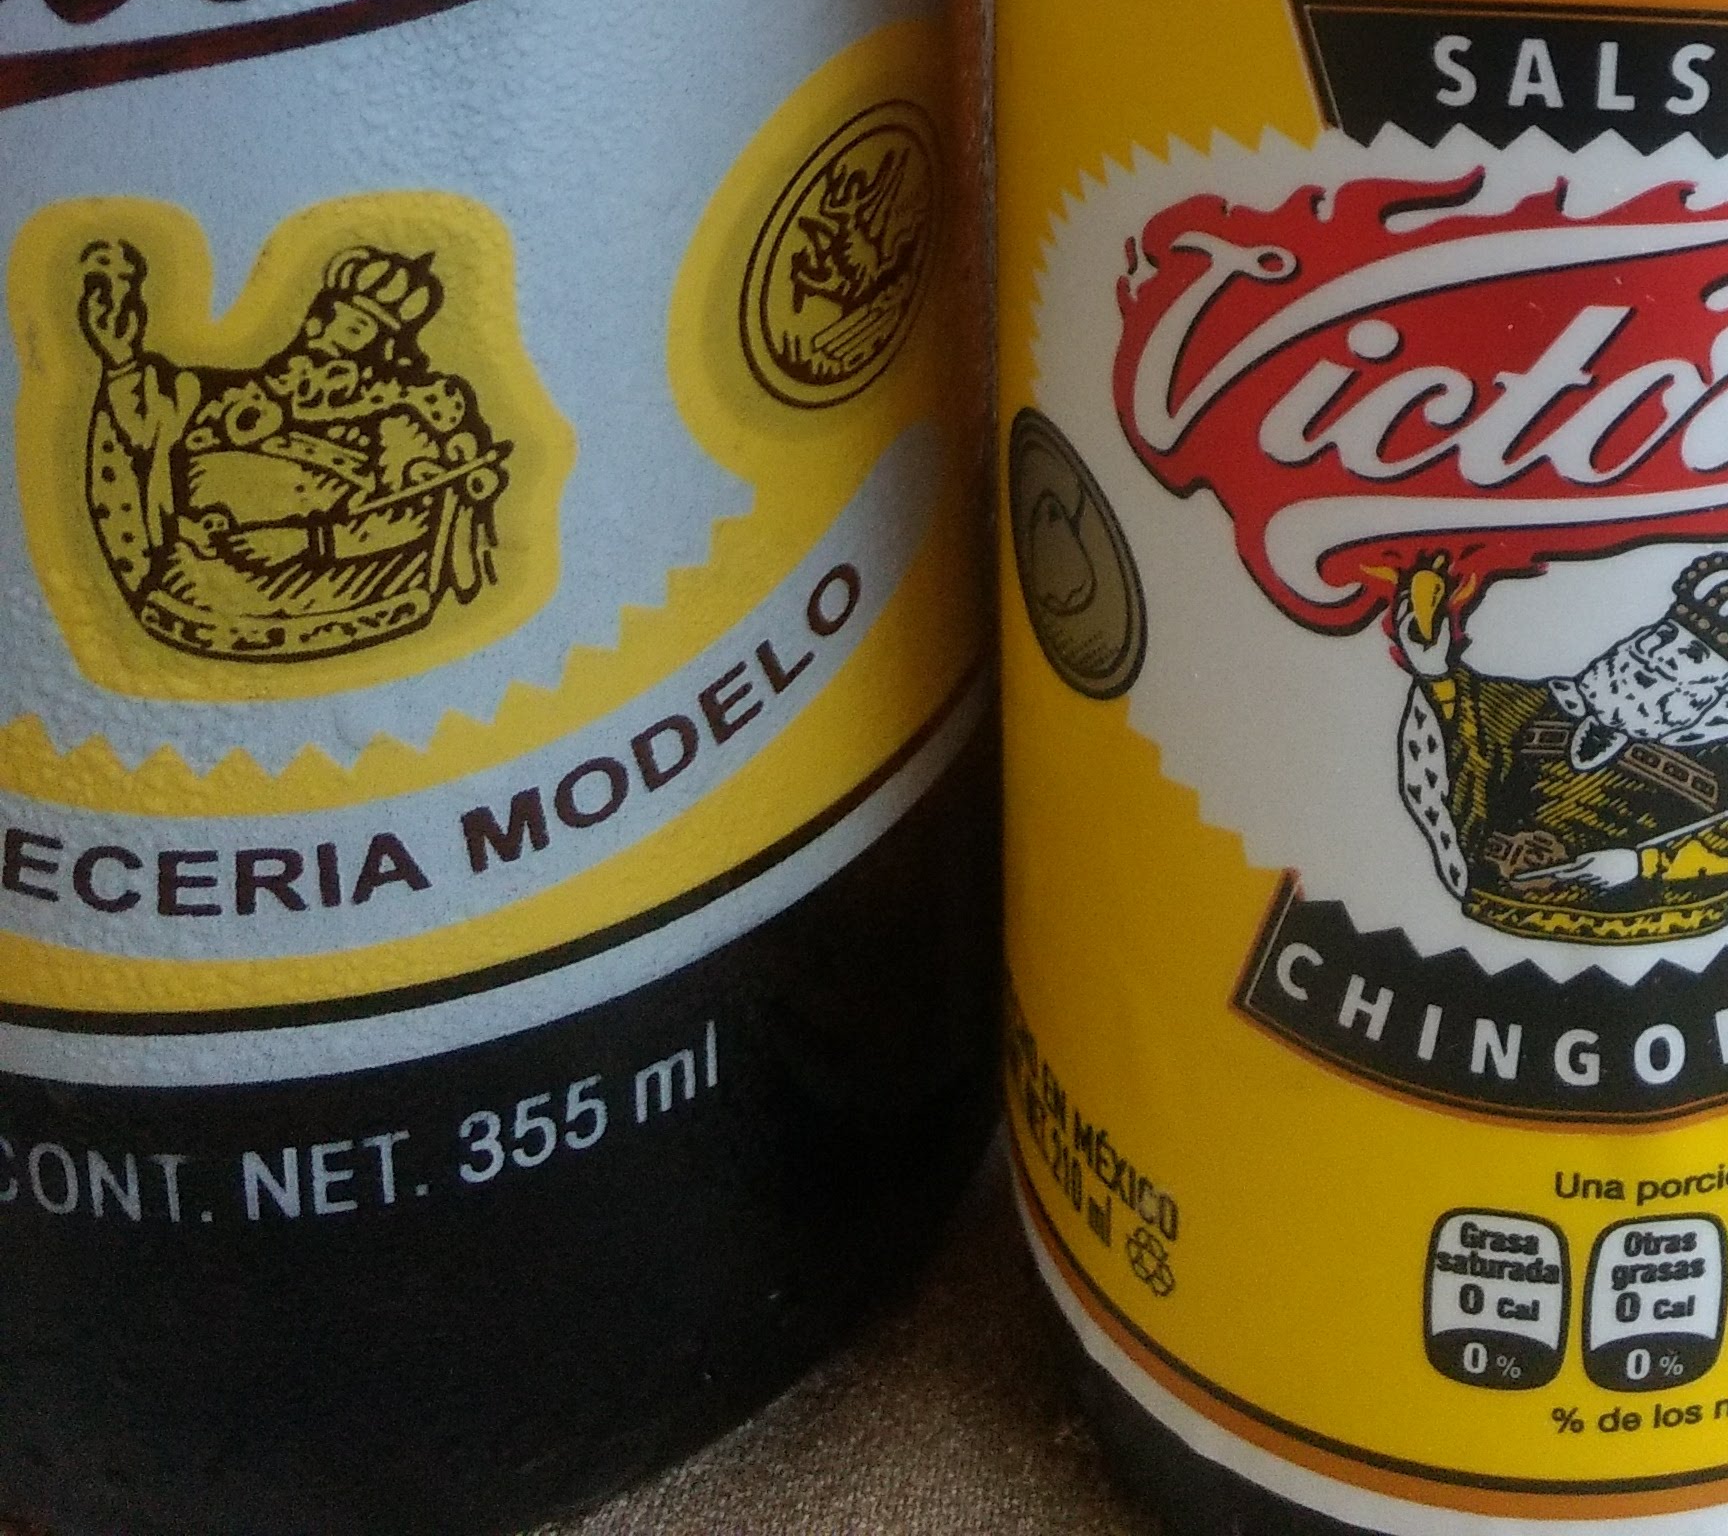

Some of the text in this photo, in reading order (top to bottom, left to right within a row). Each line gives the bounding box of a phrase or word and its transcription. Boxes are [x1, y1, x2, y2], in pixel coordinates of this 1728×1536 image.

[3, 561, 863, 919] ECERIA MODELO
[243, 1127, 431, 1220] NET.
[459, 1072, 608, 1185] 355
[632, 1019, 718, 1125] ml
[1555, 1172, 1624, 1200] Una
[1460, 1221, 1539, 1255] Grasa
[1624, 1231, 1698, 1256] Otras
[1436, 1250, 1559, 1284] saturada
[1611, 1258, 1705, 1291] grasas
[1459, 1284, 1540, 1321] 0 Cal
[1616, 1292, 1696, 1323] 0 Cal
[1463, 1343, 1521, 1378] 0 %
[1626, 1349, 1684, 1379] 0 %
[1551, 1406, 1585, 1434] %
[1597, 1406, 1643, 1433] de
[1653, 1403, 1703, 1429] los
